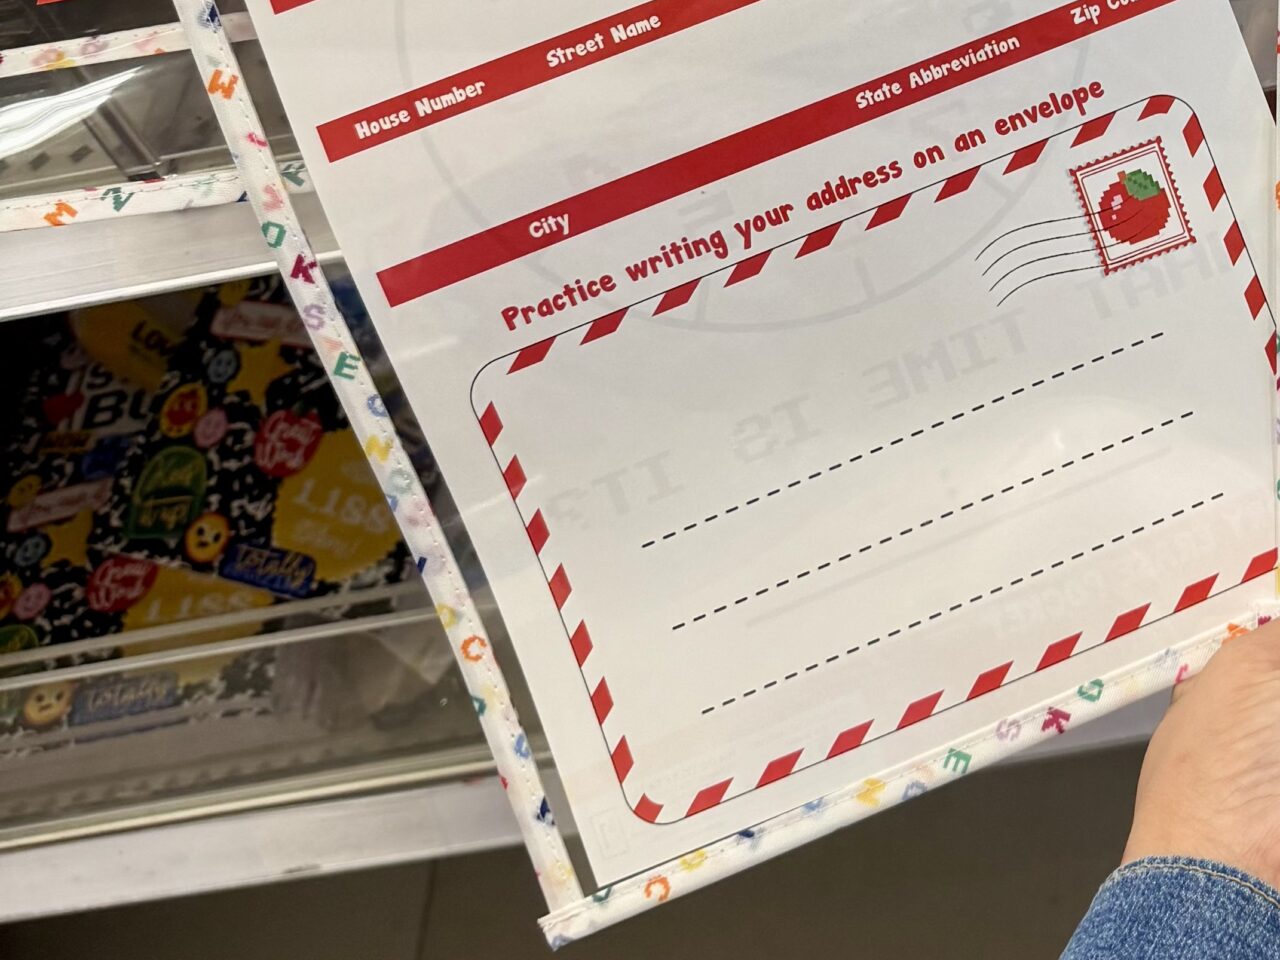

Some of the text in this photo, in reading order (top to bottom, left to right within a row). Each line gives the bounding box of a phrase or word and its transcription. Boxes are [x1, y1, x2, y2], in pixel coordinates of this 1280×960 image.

[546, 14, 662, 69] Street Name
[1071, 0, 1102, 26] Zip
[855, 35, 1020, 110] State Abbreviation
[356, 80, 486, 140] House Number
[502, 78, 1105, 332] Practice writing your address on an envelope
[529, 212, 570, 241] City
